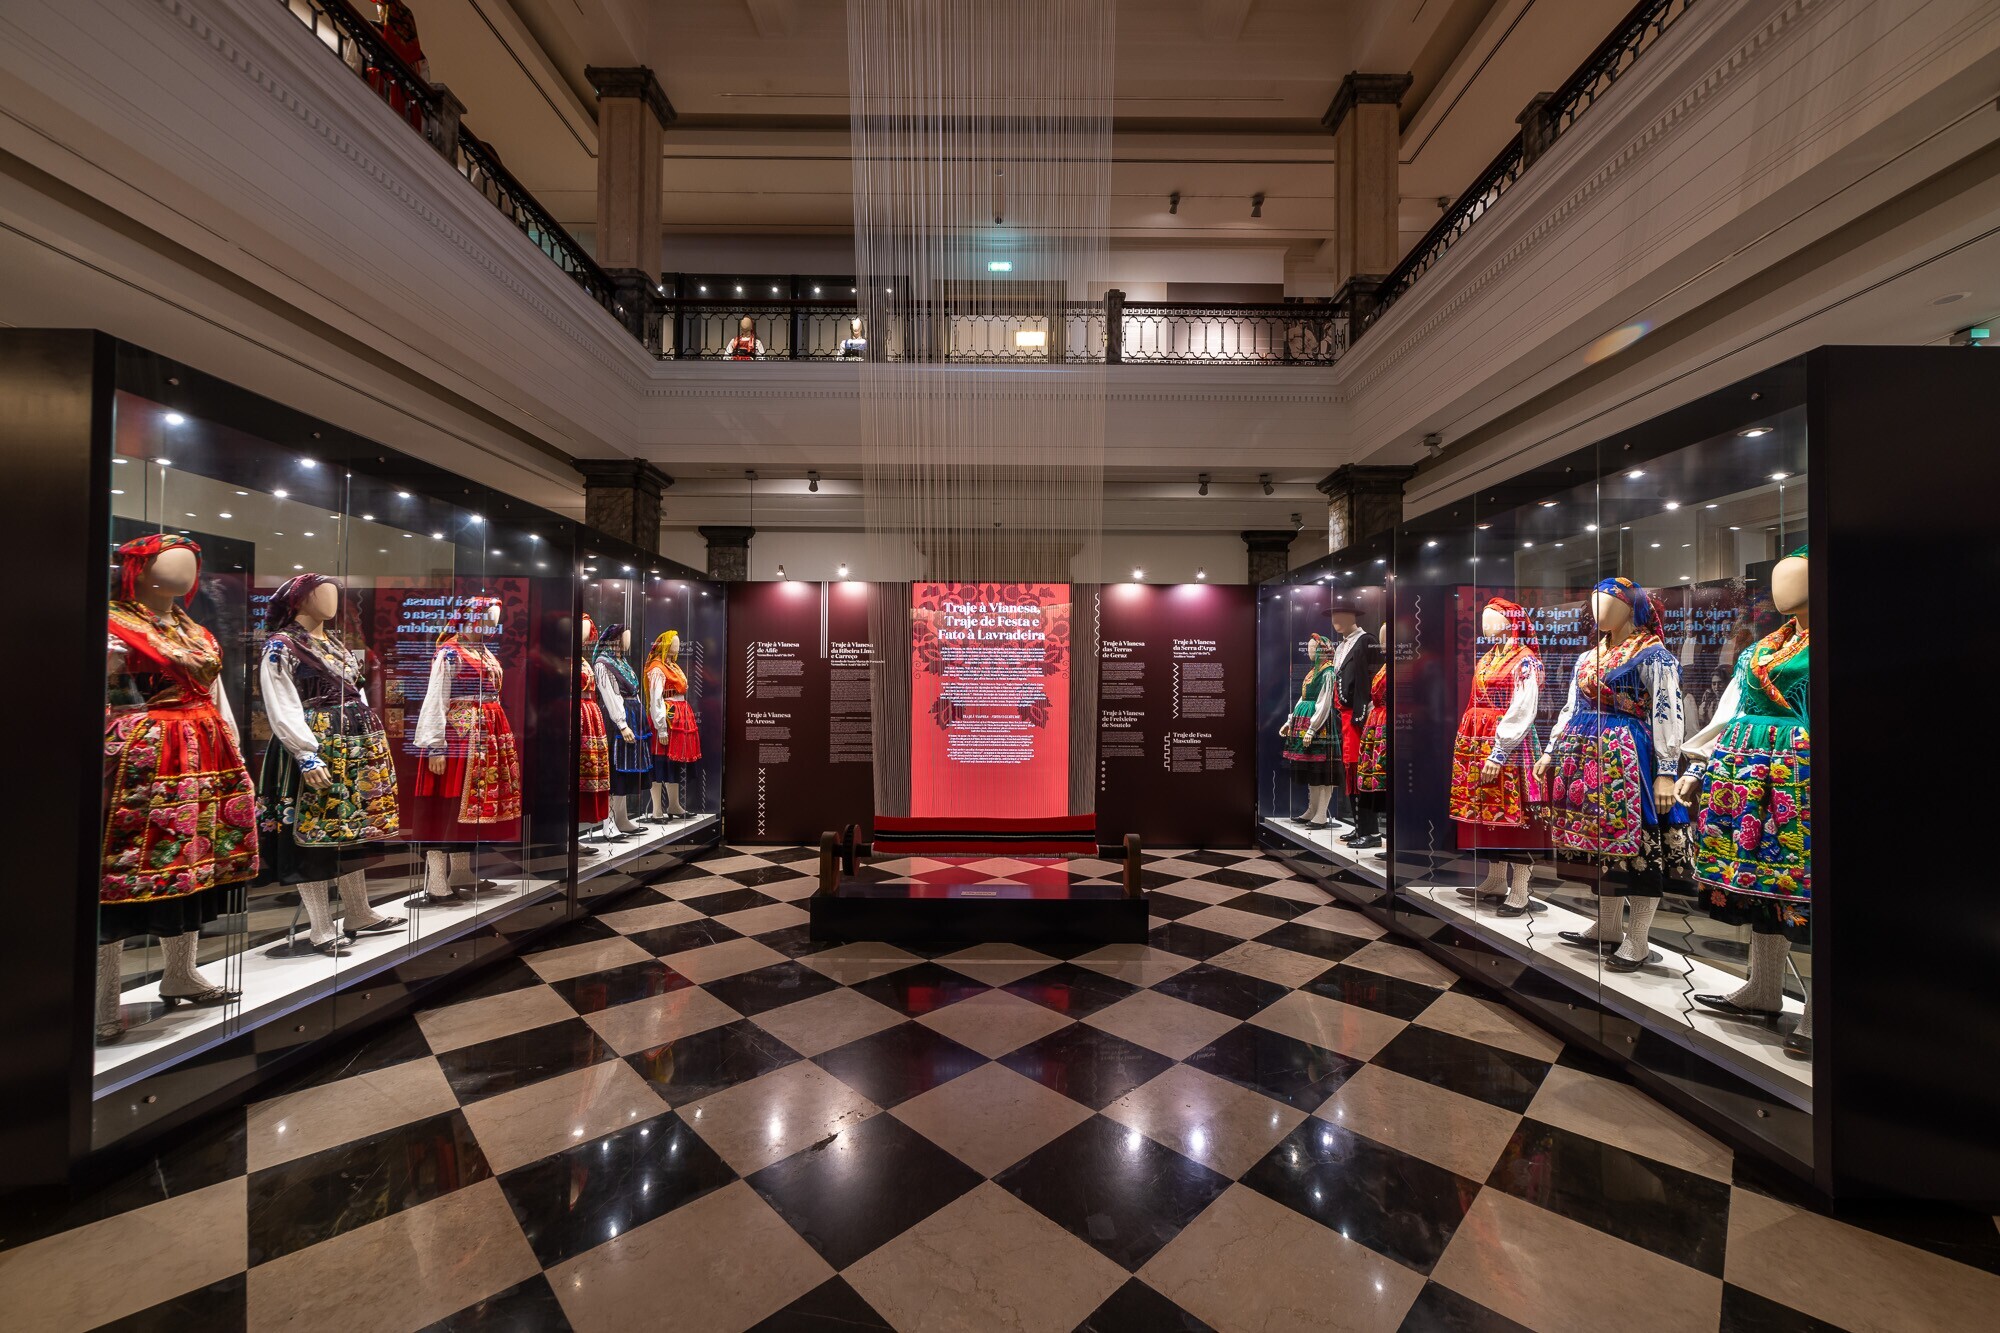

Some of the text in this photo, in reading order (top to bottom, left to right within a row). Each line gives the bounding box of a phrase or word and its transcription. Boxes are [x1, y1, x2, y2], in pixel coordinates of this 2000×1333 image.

[943, 602, 1041, 615] Traje à Vianesa,
[944, 616, 1039, 629] Traje de Festa e
[938, 629, 1046, 640] Fato à Lavradeira
